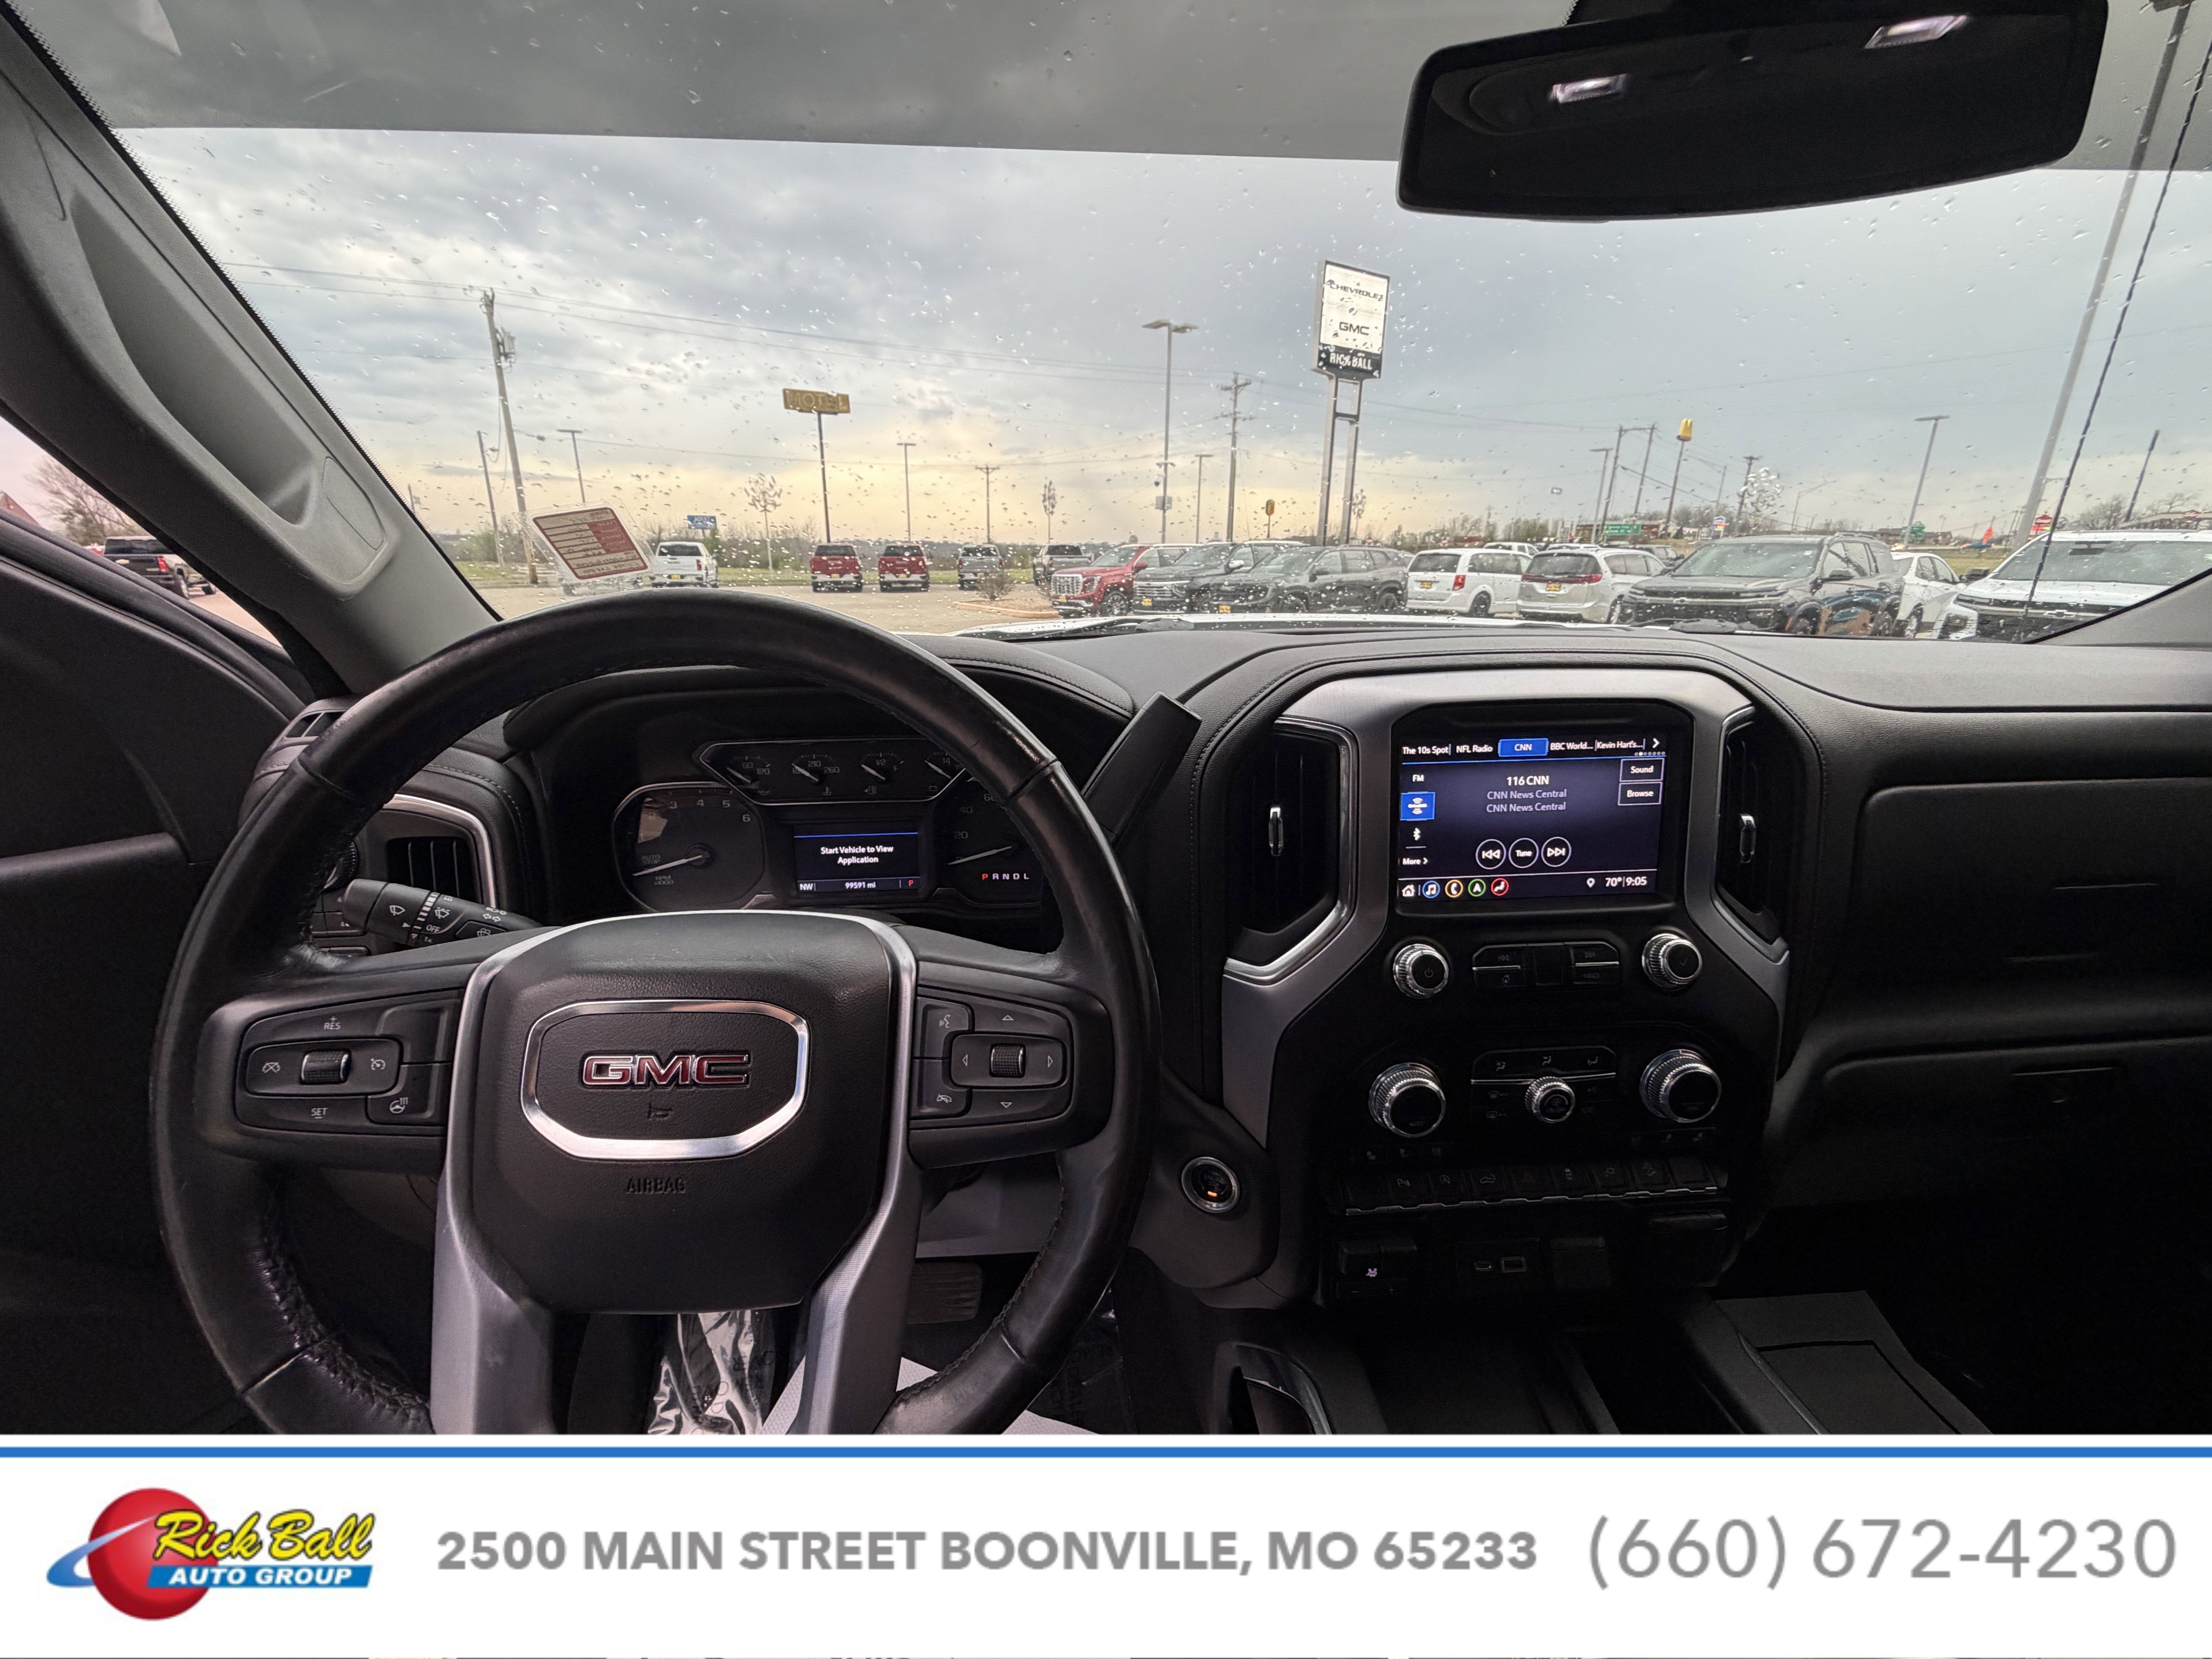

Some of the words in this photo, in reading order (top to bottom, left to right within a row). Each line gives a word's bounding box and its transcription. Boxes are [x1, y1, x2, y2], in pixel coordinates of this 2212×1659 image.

[1339, 321, 1370, 336] GMC
[1472, 744, 1493, 753] Radio
[1550, 742, 1565, 750] BBC
[1597, 740, 1615, 749] Kevin
[1432, 745, 1449, 755] Spot
[1630, 765, 1654, 774] Sound
[1506, 776, 1525, 786] 116
[1526, 775, 1549, 785] CNN
[1487, 791, 1508, 800] CNN
[1510, 790, 1534, 799] News
[1535, 788, 1567, 799] Central
[722, 800, 730, 808] 5
[1486, 804, 1508, 812] CNN
[1509, 803, 1534, 812] News
[1534, 801, 1566, 811] Central
[821, 846, 838, 854] Start
[839, 846, 866, 854] Vehicle
[837, 856, 879, 866] Application
[1605, 877, 1622, 887] 70°
[1626, 876, 1647, 886] 9:05
[426, 924, 441, 933] OFF
[324, 1022, 341, 1030] RES
[582, 1054, 750, 1085] GMC
[311, 1108, 328, 1116] SET
[625, 1178, 687, 1195] AIRBAG
